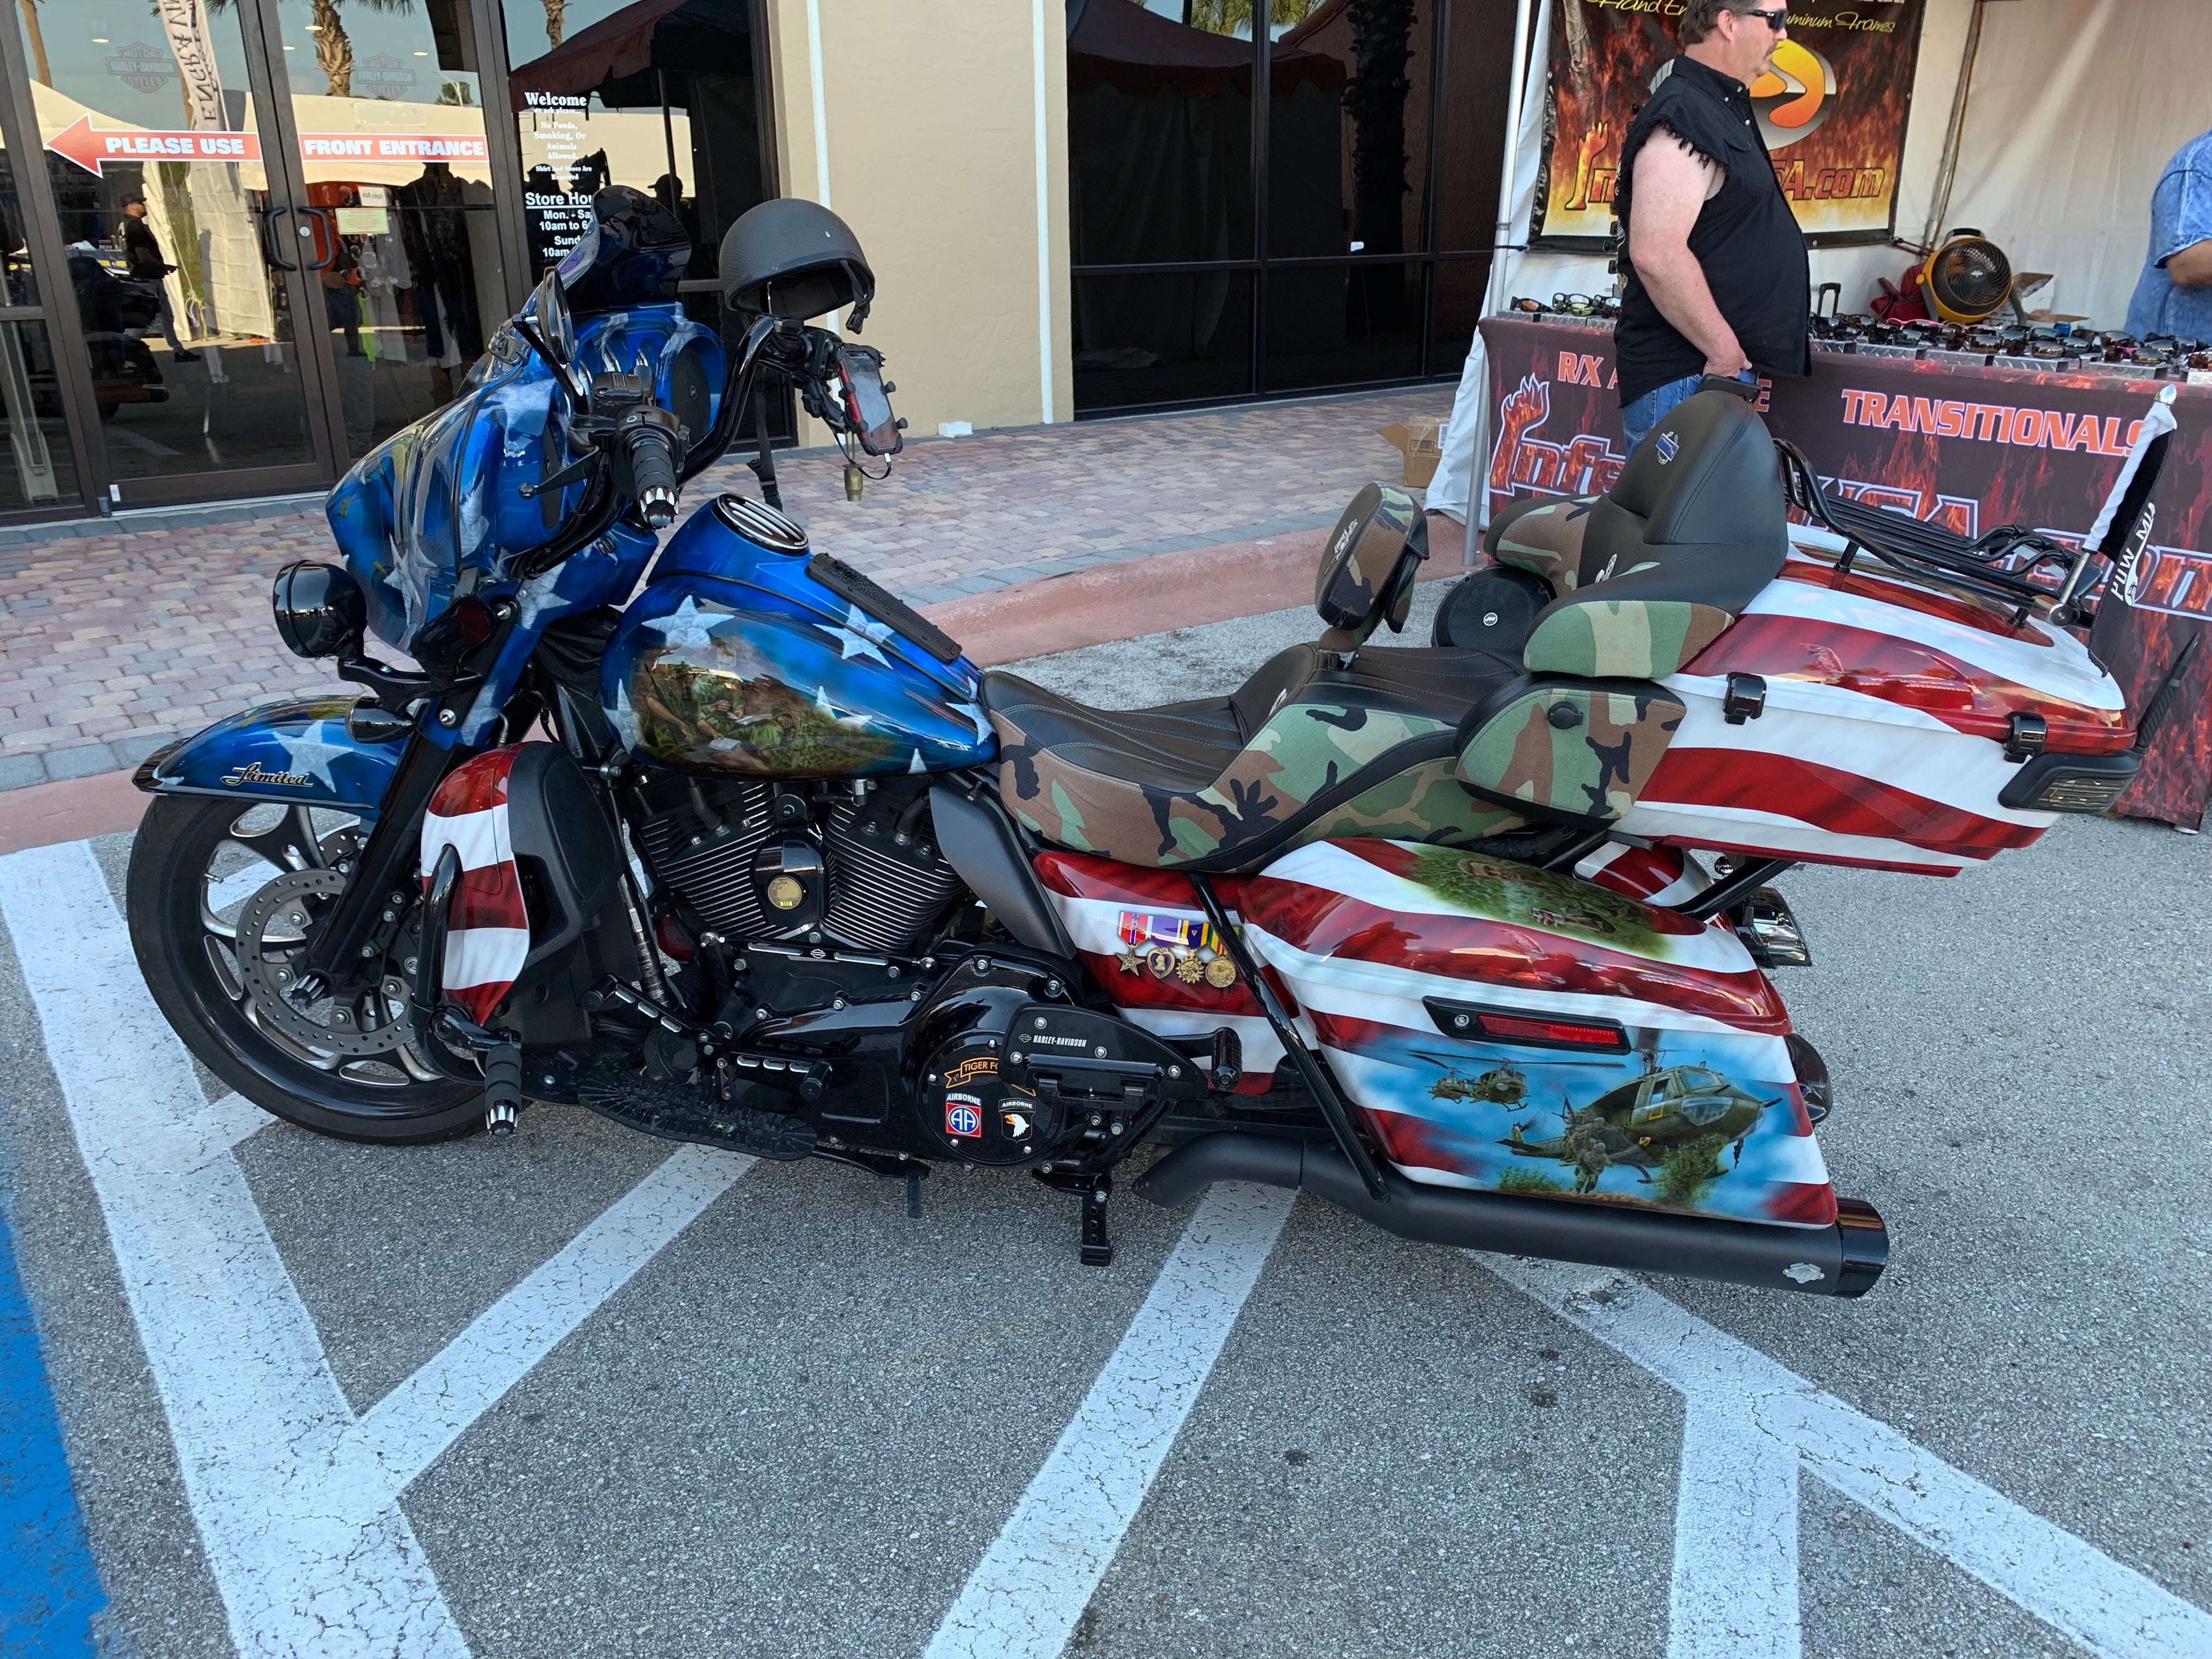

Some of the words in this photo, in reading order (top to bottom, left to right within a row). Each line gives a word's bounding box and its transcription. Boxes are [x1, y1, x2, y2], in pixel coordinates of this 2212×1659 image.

[1835, 11, 1895, 32] Frames
[524, 92, 588, 106] Welcome
[534, 131, 573, 141] Smoking,
[105, 137, 195, 154] PLEASE
[200, 138, 245, 154] USE
[304, 139, 373, 155] FRONT
[379, 140, 484, 156] ENTRANCE
[525, 192, 565, 206] Store
[543, 210, 569, 219] Mon.
[539, 221, 567, 230] 10am
[569, 221, 579, 230] to
[543, 247, 571, 257] 10am
[1558, 351, 1604, 387] R/X
[220, 762, 314, 787] Limited
[1033, 1035, 1087, 1047] HARLEY-DAVIDSON
[964, 1061, 988, 1072] TIGER
[946, 1093, 981, 1106] AIRBORNE
